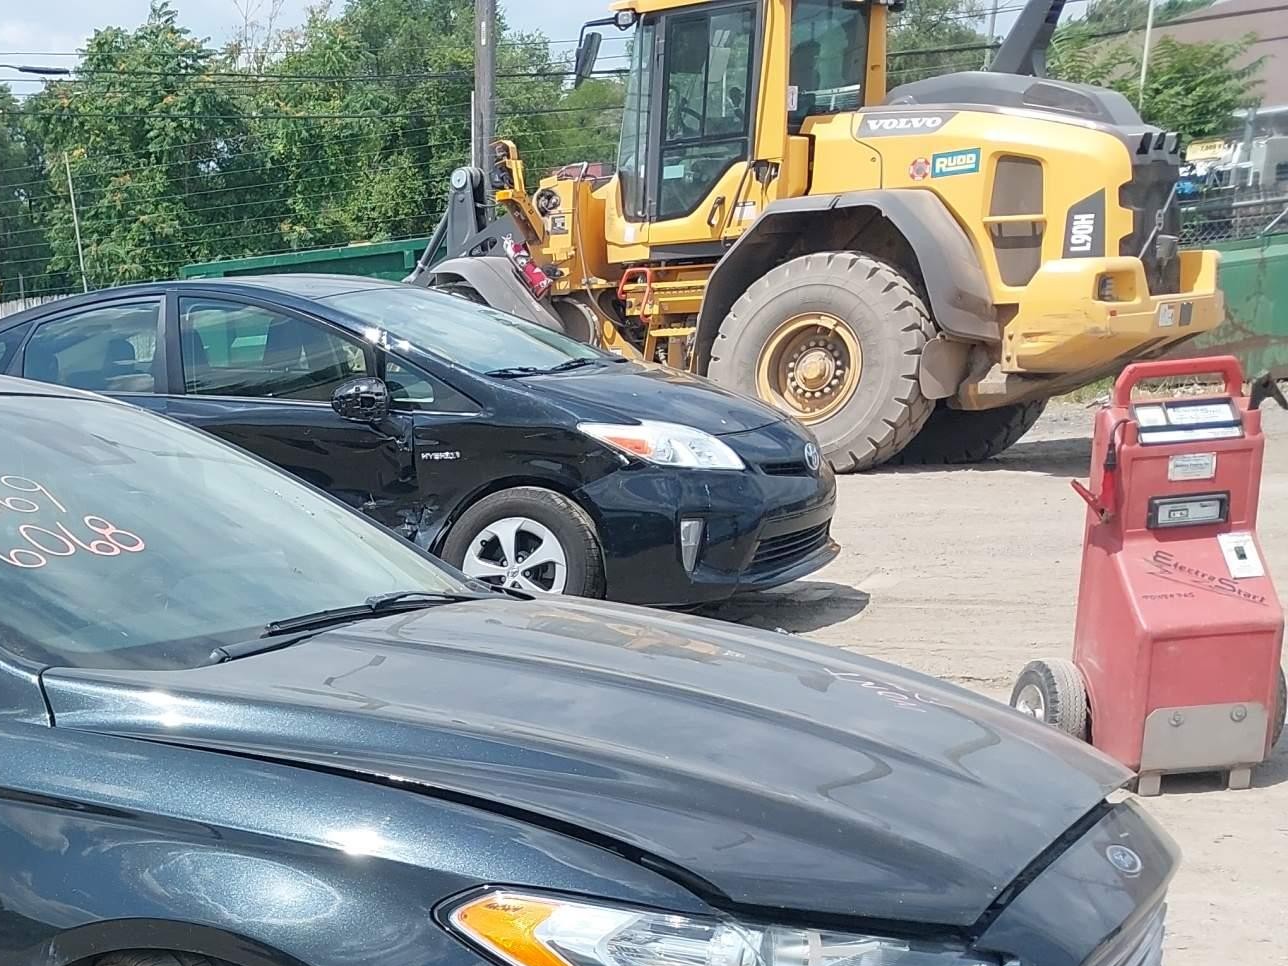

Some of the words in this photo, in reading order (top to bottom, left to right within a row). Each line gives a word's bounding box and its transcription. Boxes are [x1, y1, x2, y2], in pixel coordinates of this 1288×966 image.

[867, 116, 943, 130] VOLVO
[934, 153, 977, 173] RUDD
[1069, 213, 1096, 252] L90H
